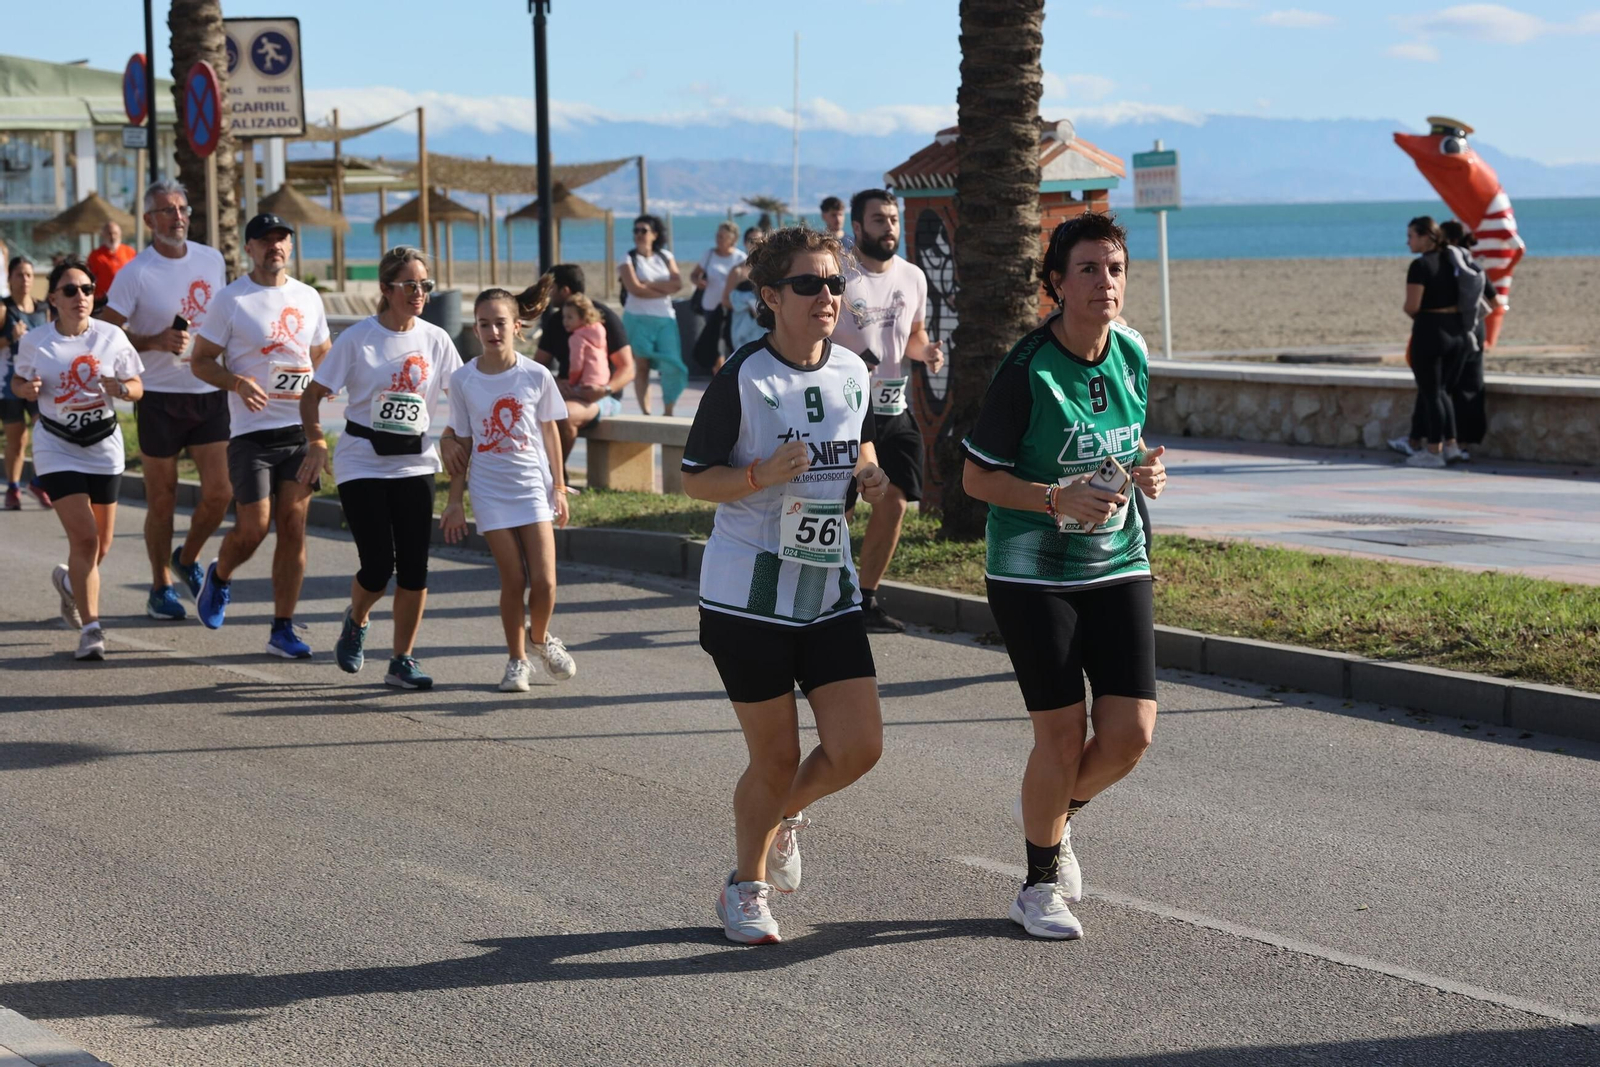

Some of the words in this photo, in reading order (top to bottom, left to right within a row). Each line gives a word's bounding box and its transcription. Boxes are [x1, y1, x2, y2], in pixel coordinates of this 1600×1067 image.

[257, 86, 291, 94] PATINES
[232, 101, 289, 113] CARRIL
[274, 373, 310, 391] 270
[879, 388, 901, 404] 52
[1087, 374, 1109, 415] 9
[379, 402, 420, 421] 853
[803, 385, 825, 424] 9
[66, 409, 103, 429] 263
[795, 516, 842, 546] 561
[784, 548, 798, 557] 024
